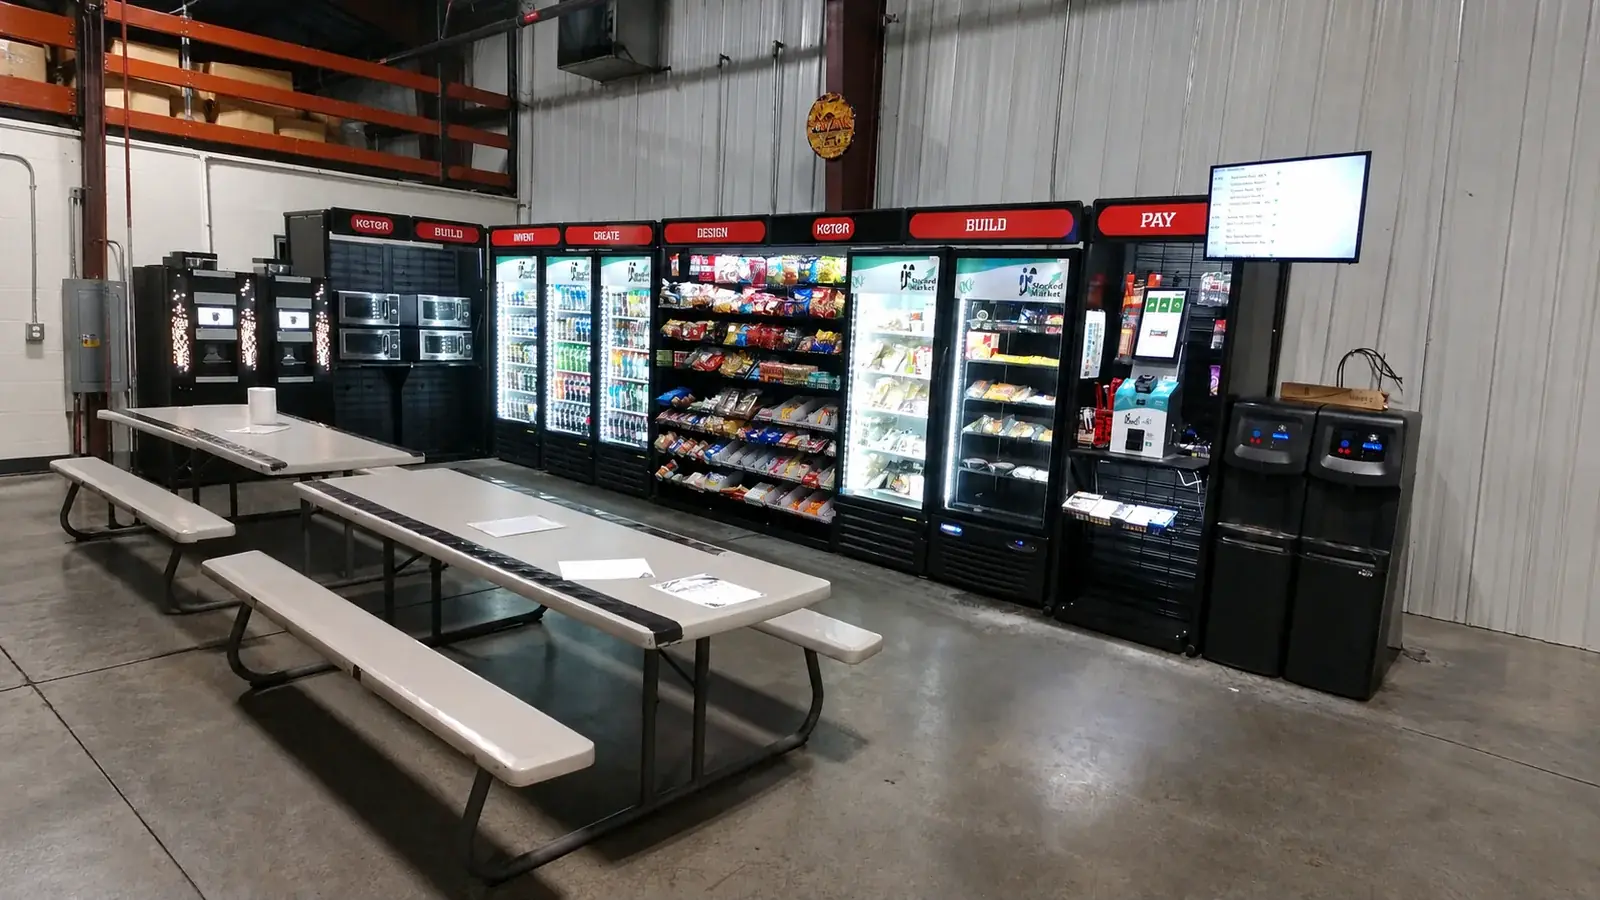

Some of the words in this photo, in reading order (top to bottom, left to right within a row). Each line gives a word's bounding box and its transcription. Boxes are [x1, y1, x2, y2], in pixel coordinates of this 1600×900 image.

[1140, 211, 1177, 228] PAY
[965, 218, 1007, 232] BUILD
[434, 227, 463, 238] BUILD
[513, 232, 534, 242] INVENT
[593, 231, 620, 241] CREATE
[697, 227, 728, 238] DESIGN
[1032, 282, 1063, 290] Stocked
[1030, 289, 1061, 298] Market
